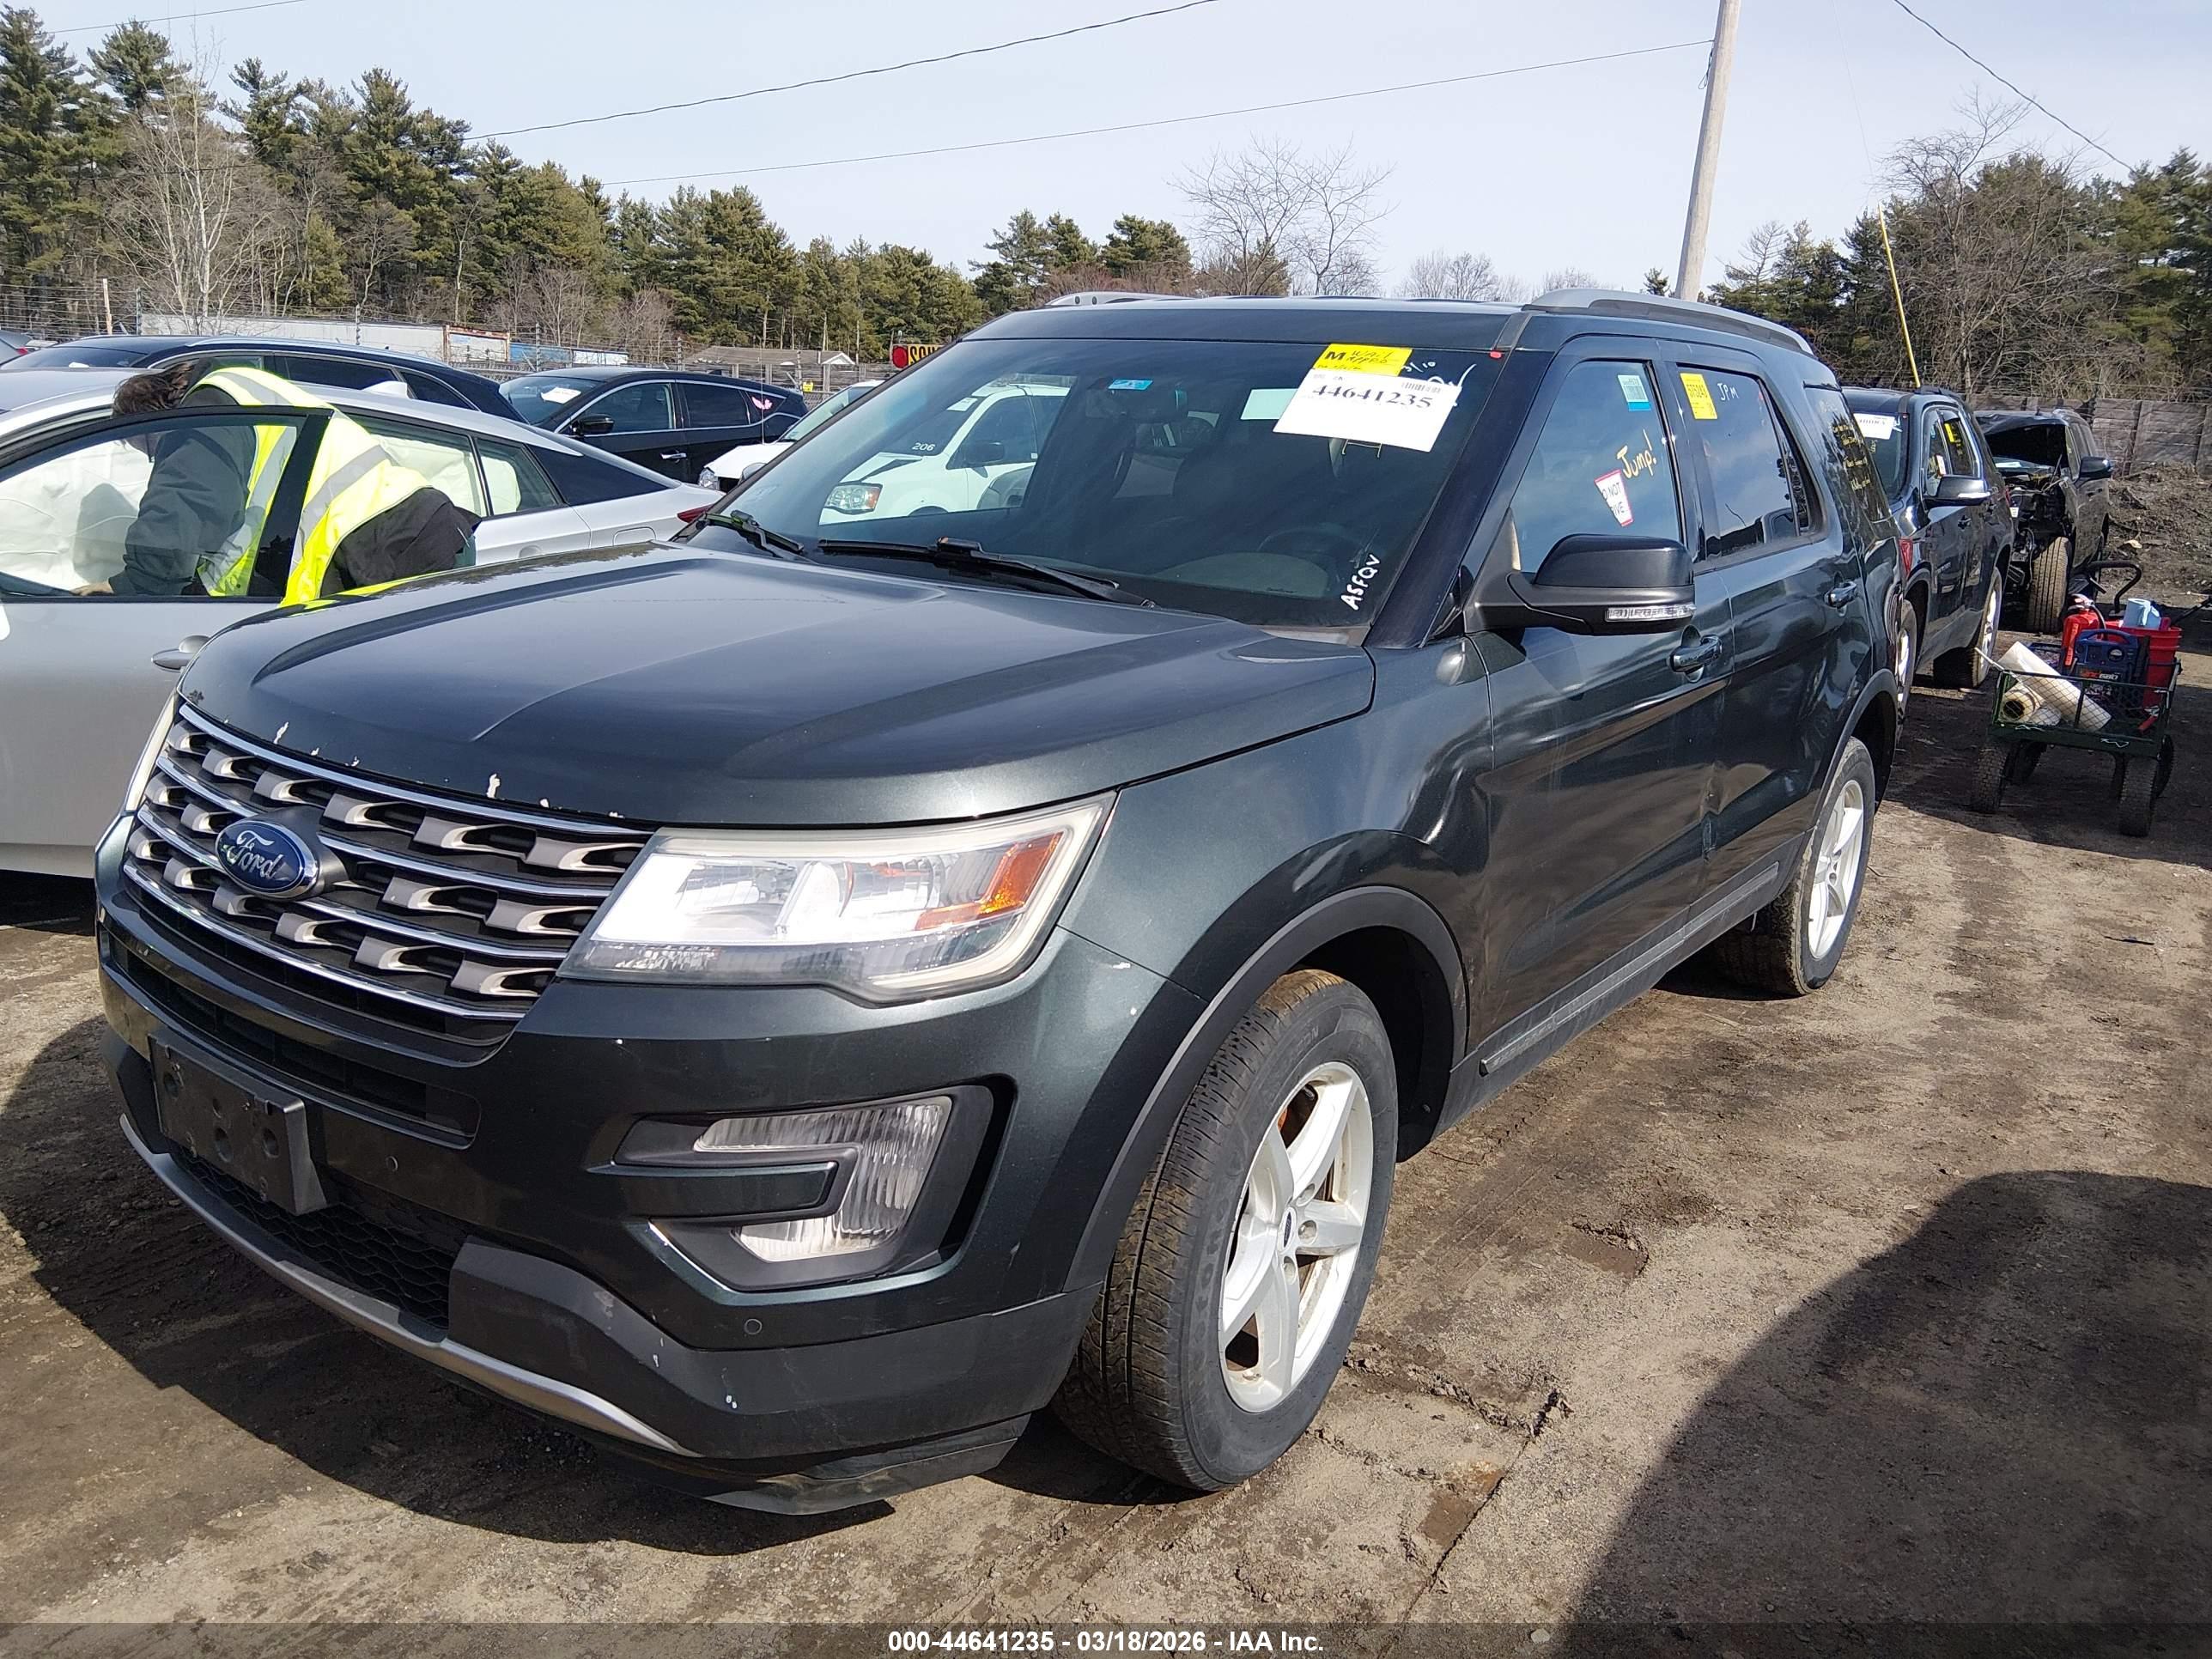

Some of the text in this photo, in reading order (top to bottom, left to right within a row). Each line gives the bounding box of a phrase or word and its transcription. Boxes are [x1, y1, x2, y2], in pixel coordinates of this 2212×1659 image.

[1312, 385, 1433, 409] 44641235
[911, 441, 936, 452] 206
[1610, 501, 1625, 516] IVE
[223, 830, 284, 880] Ford
